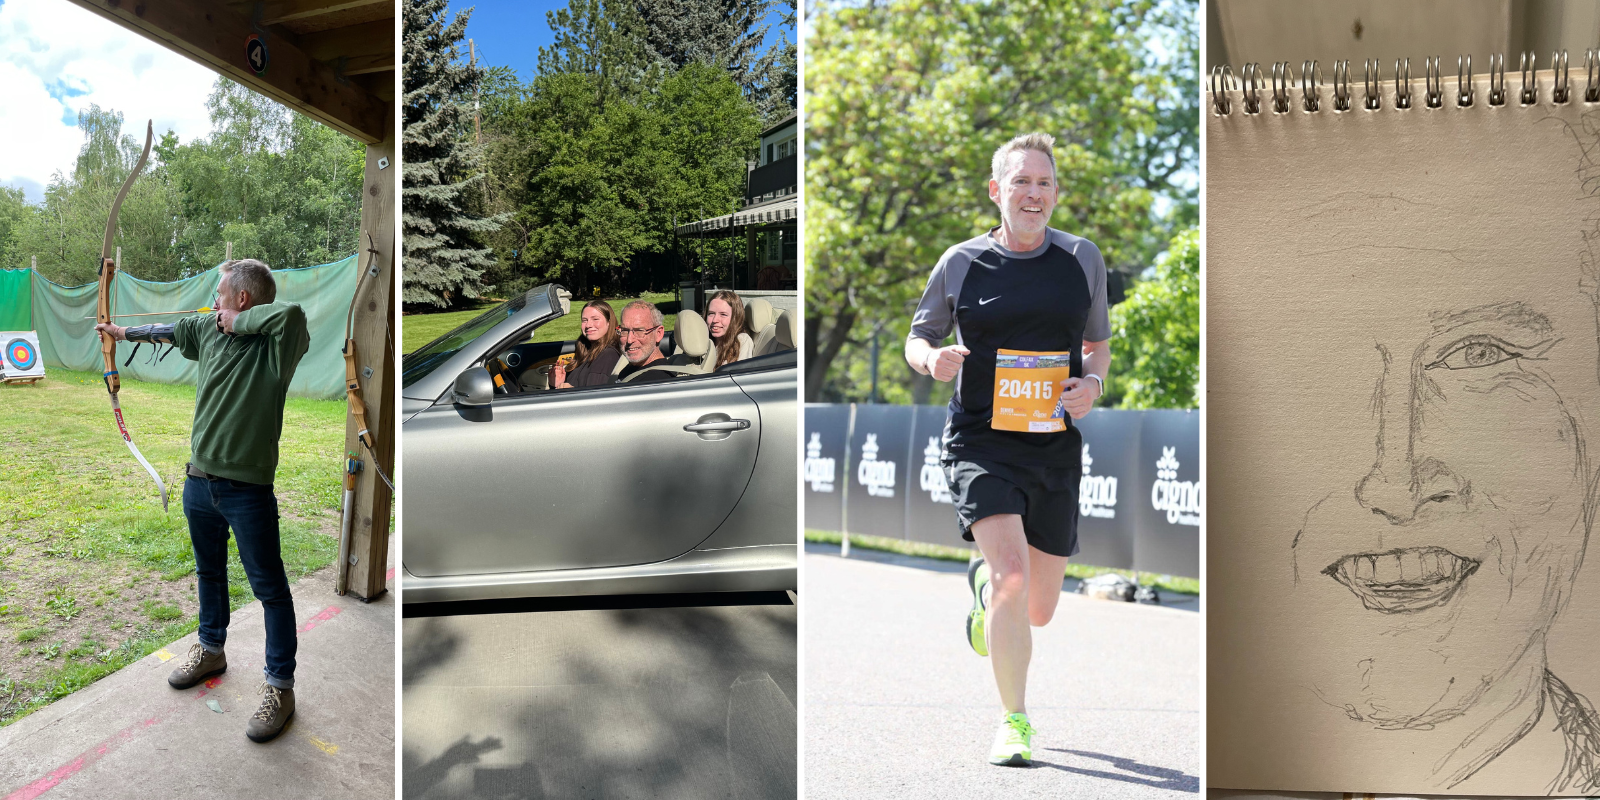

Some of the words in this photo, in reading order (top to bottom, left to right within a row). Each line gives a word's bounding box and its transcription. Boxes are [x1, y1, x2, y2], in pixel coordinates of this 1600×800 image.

[251, 45, 262, 68] 4
[998, 379, 1053, 399] 20415
[1053, 396, 1063, 417] 202
[858, 459, 896, 496] cigna
[920, 464, 950, 503] cig
